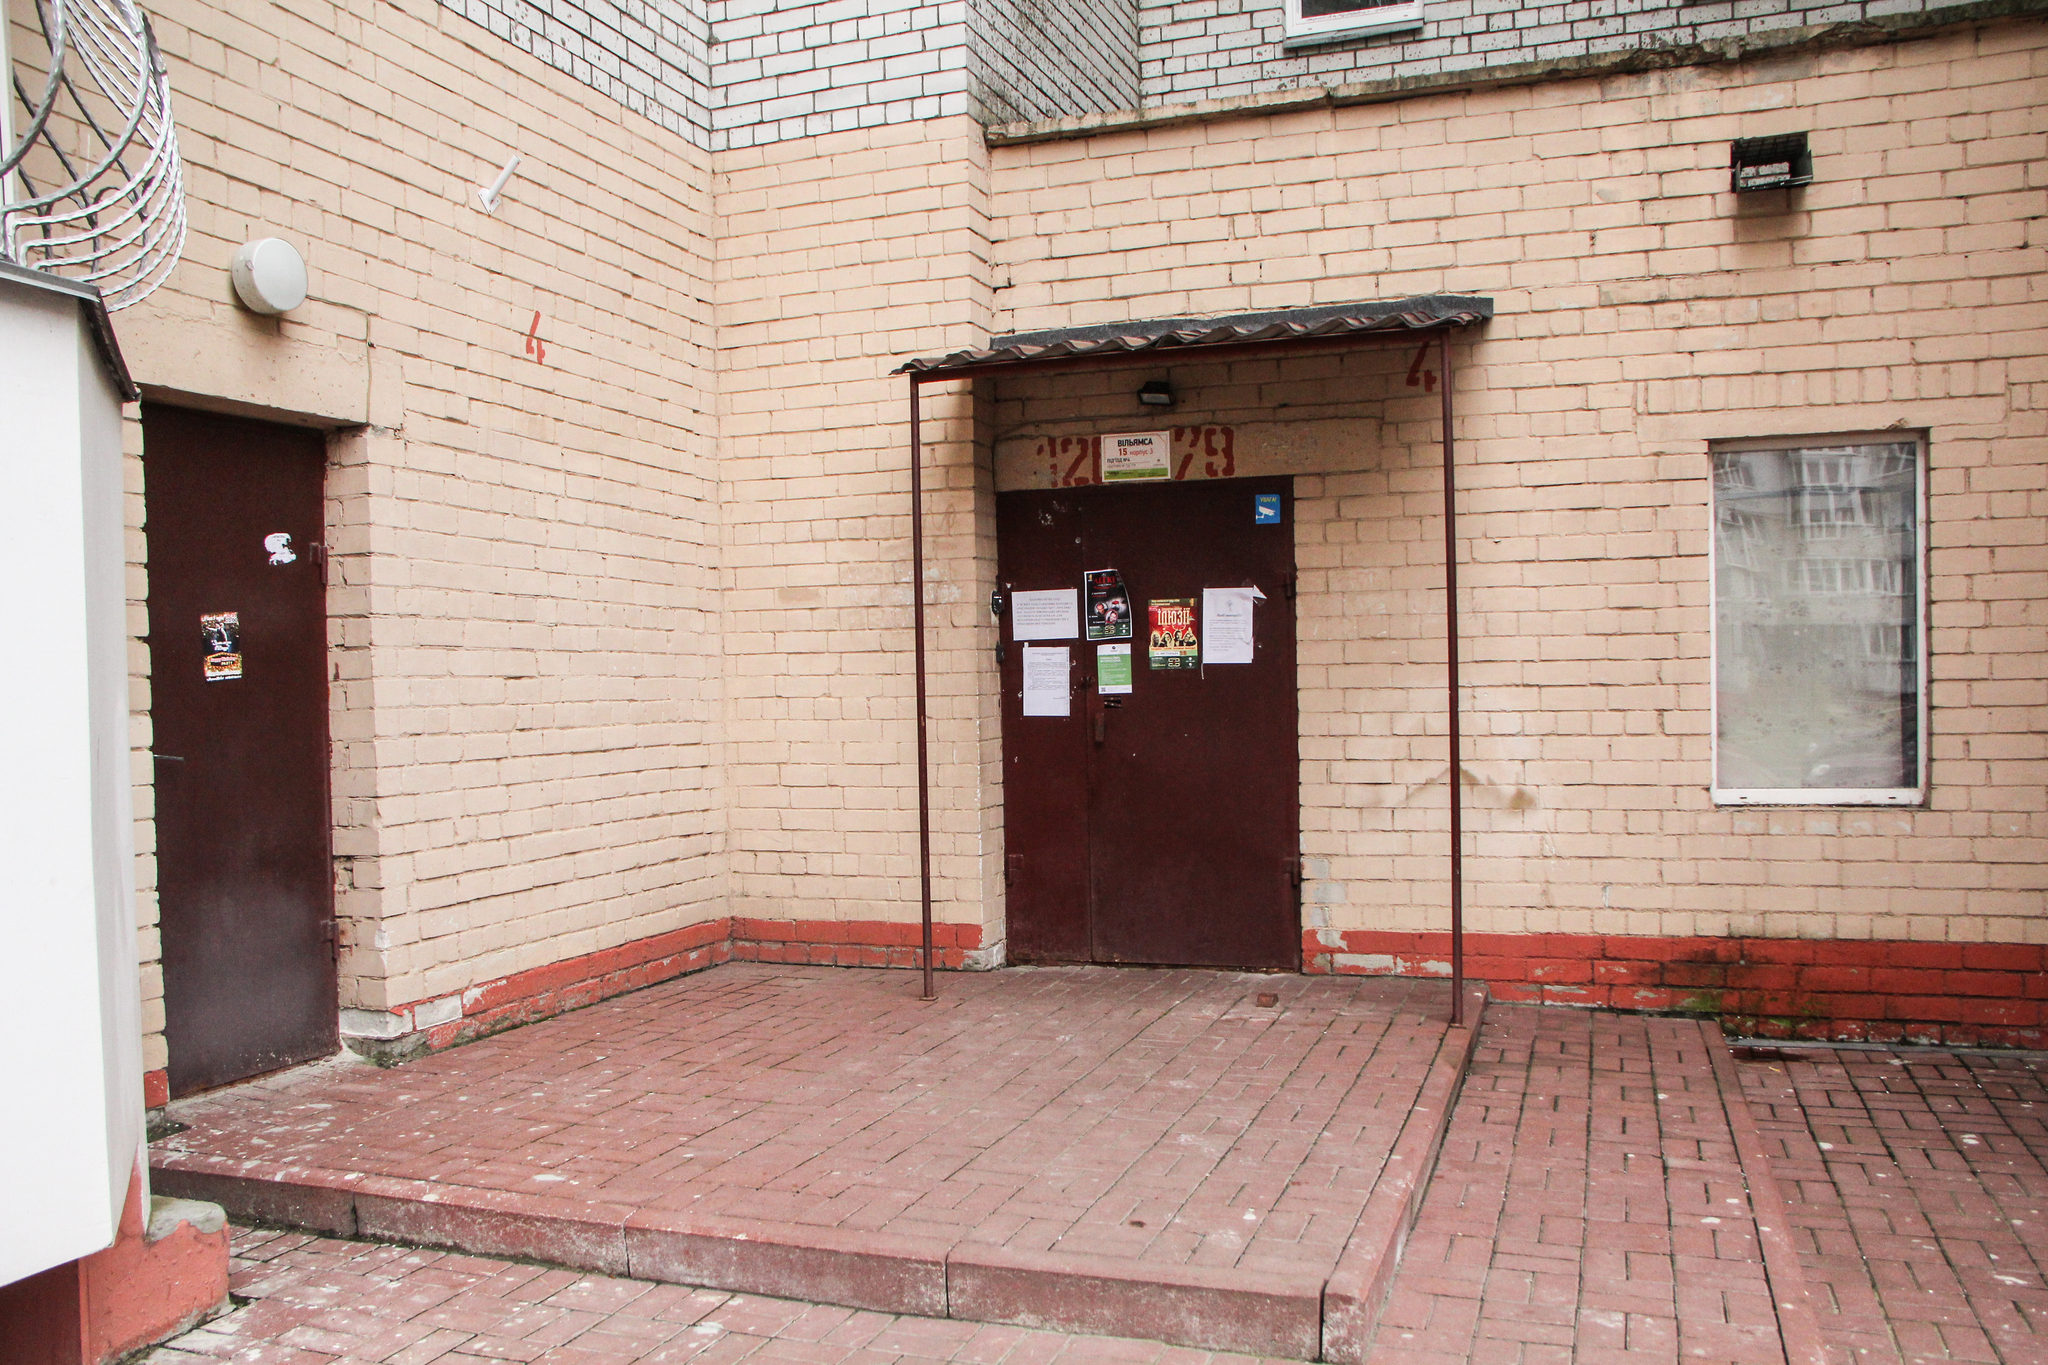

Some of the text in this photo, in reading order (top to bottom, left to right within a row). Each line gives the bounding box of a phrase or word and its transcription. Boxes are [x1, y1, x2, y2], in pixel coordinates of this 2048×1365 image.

[526, 311, 545, 365] 4
[1406, 340, 1437, 392] 4
[1117, 438, 1153, 447] ВІЛЬЯМСА
[1118, 448, 1127, 456] 15
